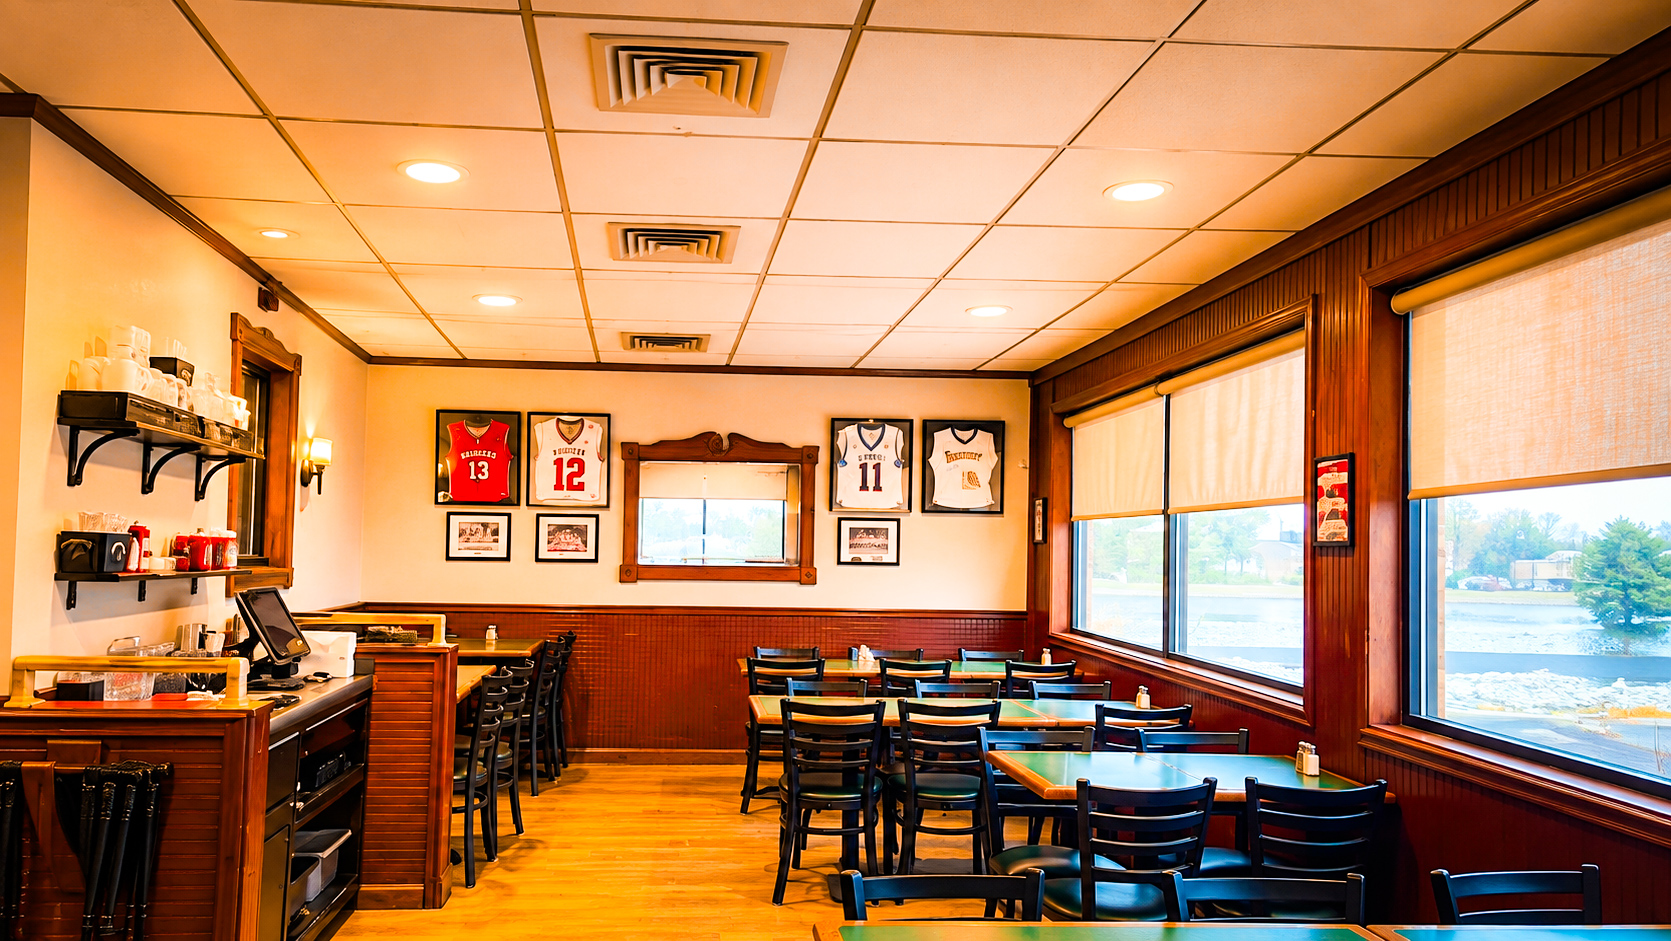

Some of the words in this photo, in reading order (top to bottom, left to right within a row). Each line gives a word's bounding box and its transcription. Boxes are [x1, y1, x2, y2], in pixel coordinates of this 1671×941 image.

[468, 460, 489, 480] 13
[553, 457, 585, 491] 12
[858, 462, 883, 492] 11
